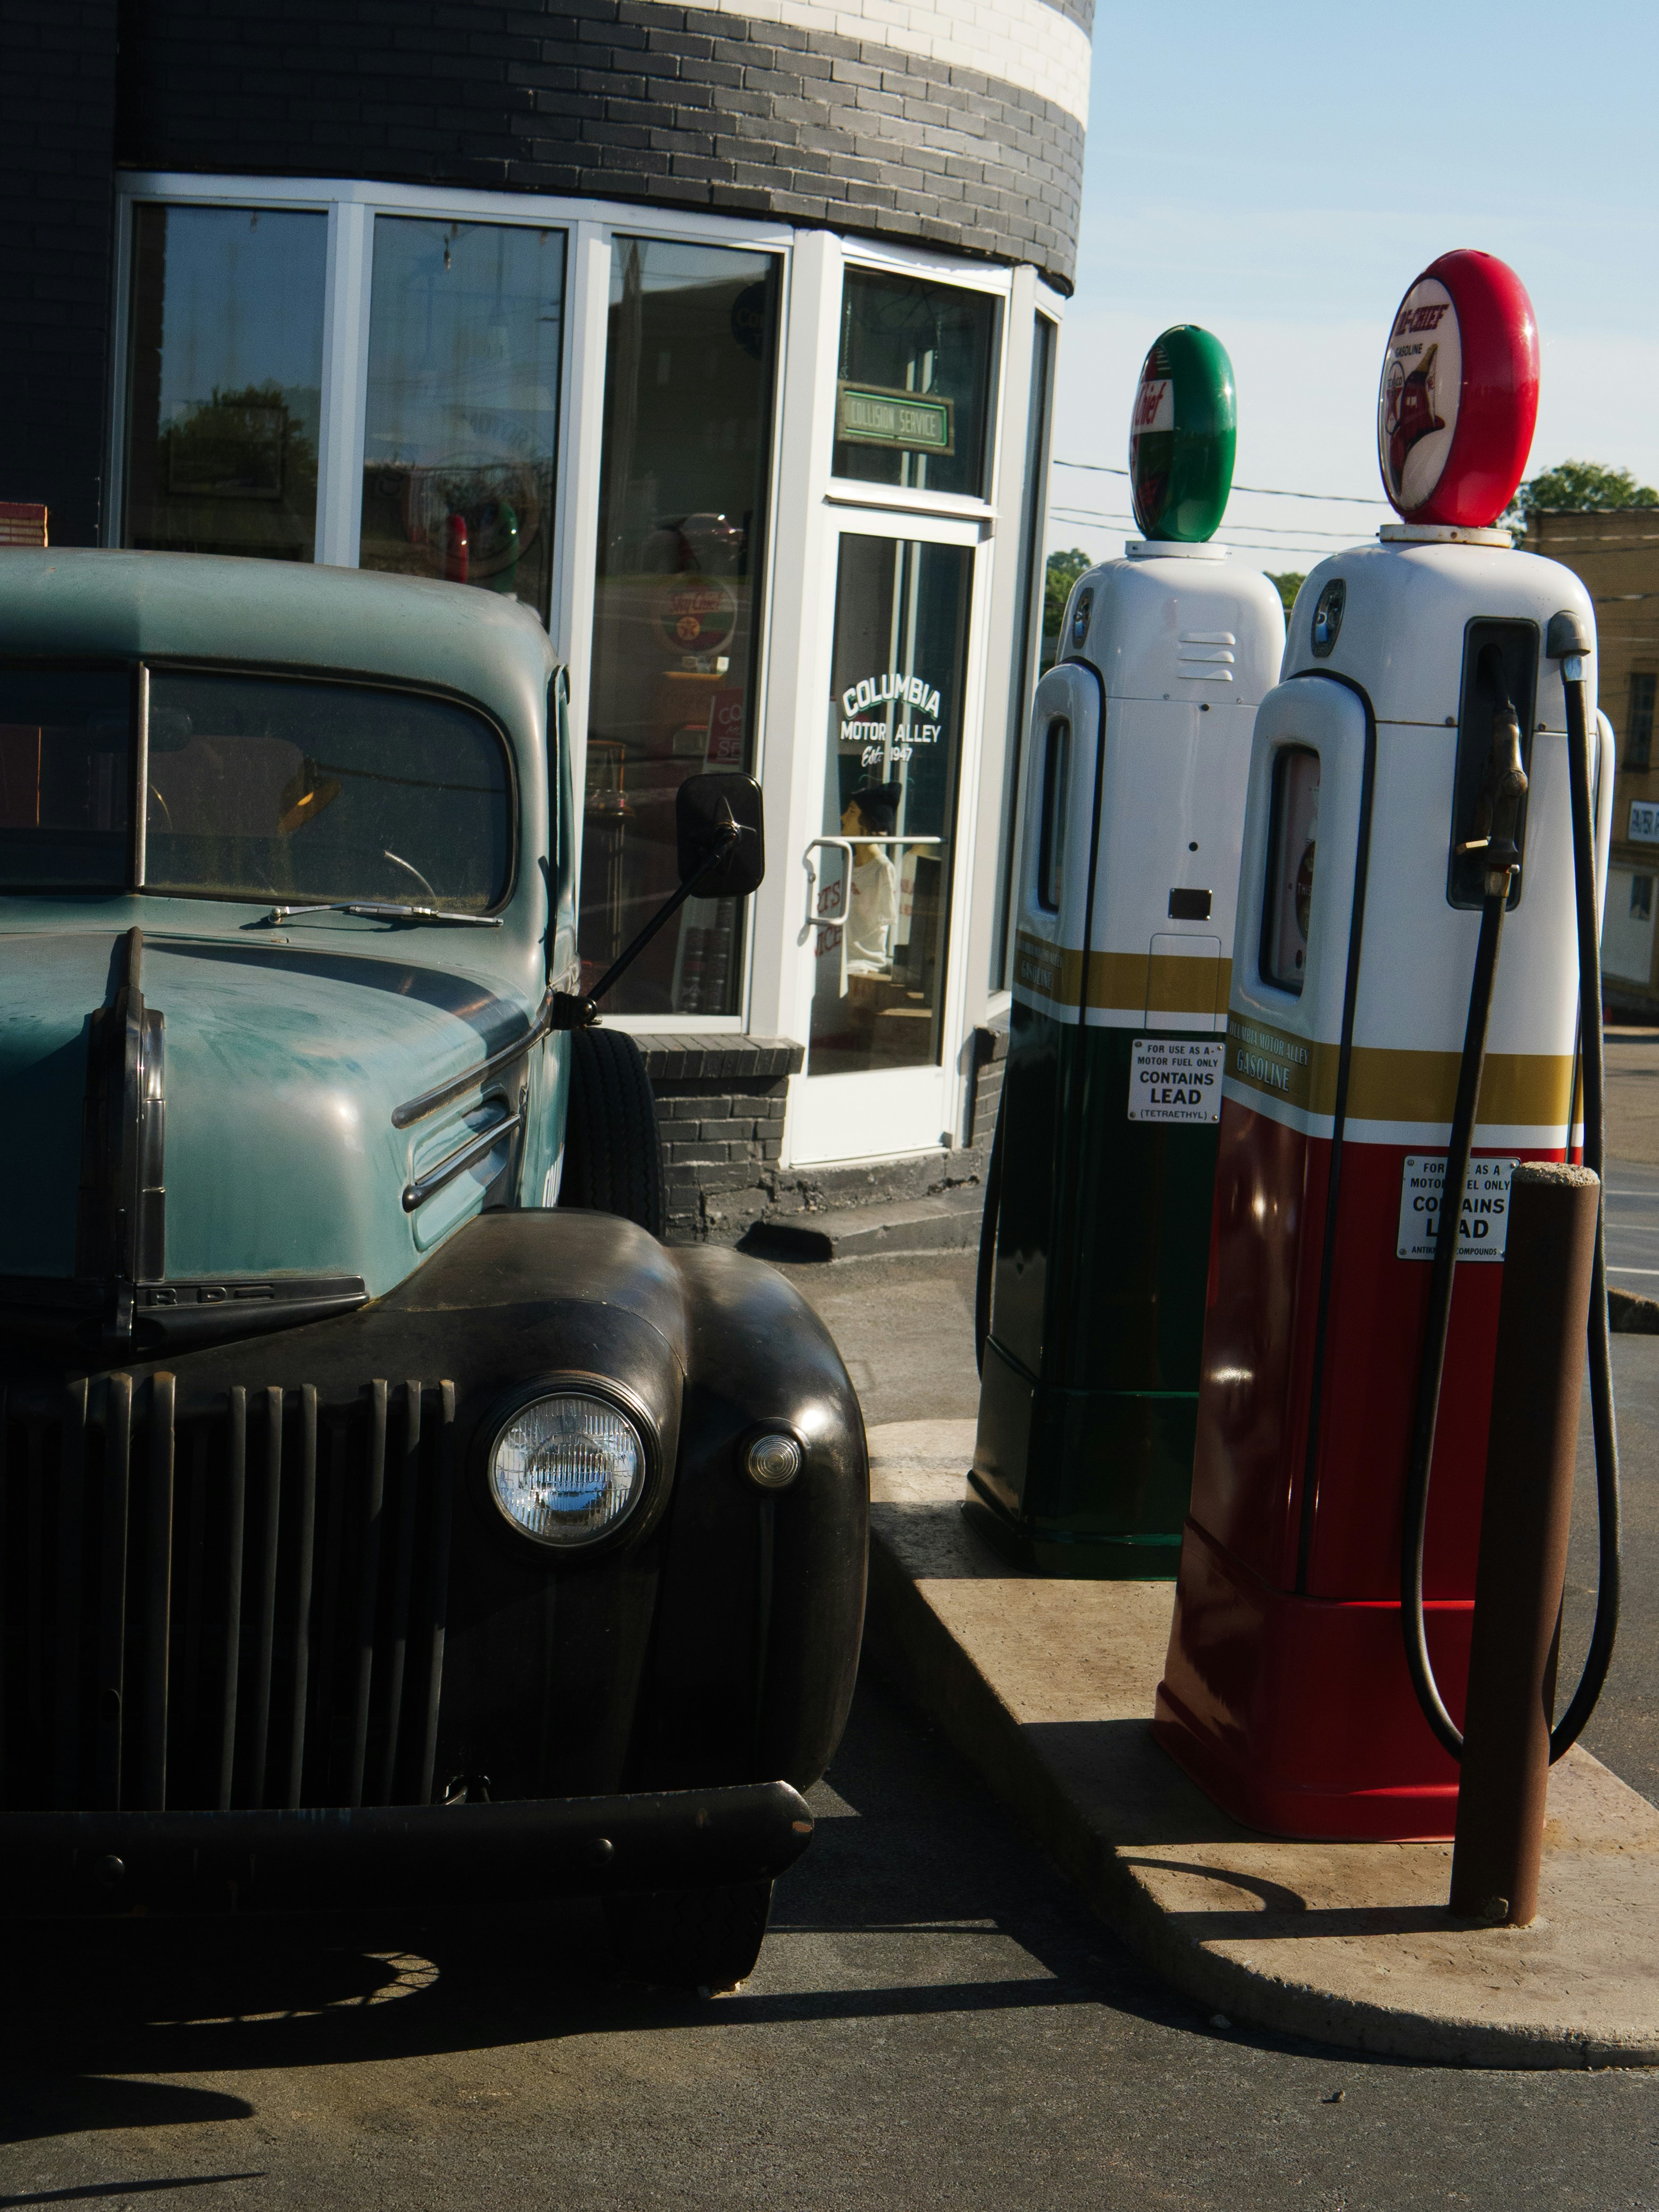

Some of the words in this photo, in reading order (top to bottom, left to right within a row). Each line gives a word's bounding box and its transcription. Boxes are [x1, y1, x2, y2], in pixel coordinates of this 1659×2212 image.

[899, 409, 935, 437] SERVICE
[842, 673, 941, 719] COLUMBIA
[840, 720, 886, 741] MOTOR
[894, 724, 941, 743] ALLEY
[890, 747, 913, 761] 1947
[1147, 1044, 1164, 1053] FOR
[1169, 1045, 1185, 1054] USE
[1189, 1046, 1200, 1055] AS
[1229, 1020, 1258, 1046] OLUMBIA
[1260, 1032, 1284, 1057] MOTOR
[1287, 1043, 1309, 1066] ALLEY
[1137, 1057, 1168, 1066] MOTOR
[1172, 1058, 1193, 1067] FUEL
[1197, 1059, 1218, 1067] ONLY
[1139, 1070, 1214, 1085] CONTAINS
[1237, 1049, 1291, 1092] GASOLINE
[1150, 1088, 1202, 1105] LEAD
[1140, 1109, 1208, 1121] (TETRAETHYL)
[1423, 1163, 1445, 1174] FOR
[1475, 1165, 1489, 1175] AS
[1493, 1166, 1500, 1176] A
[1484, 1180, 1511, 1191] ONLY
[1413, 1196, 1505, 1214] COAINS
[1426, 1218, 1489, 1239] LAD
